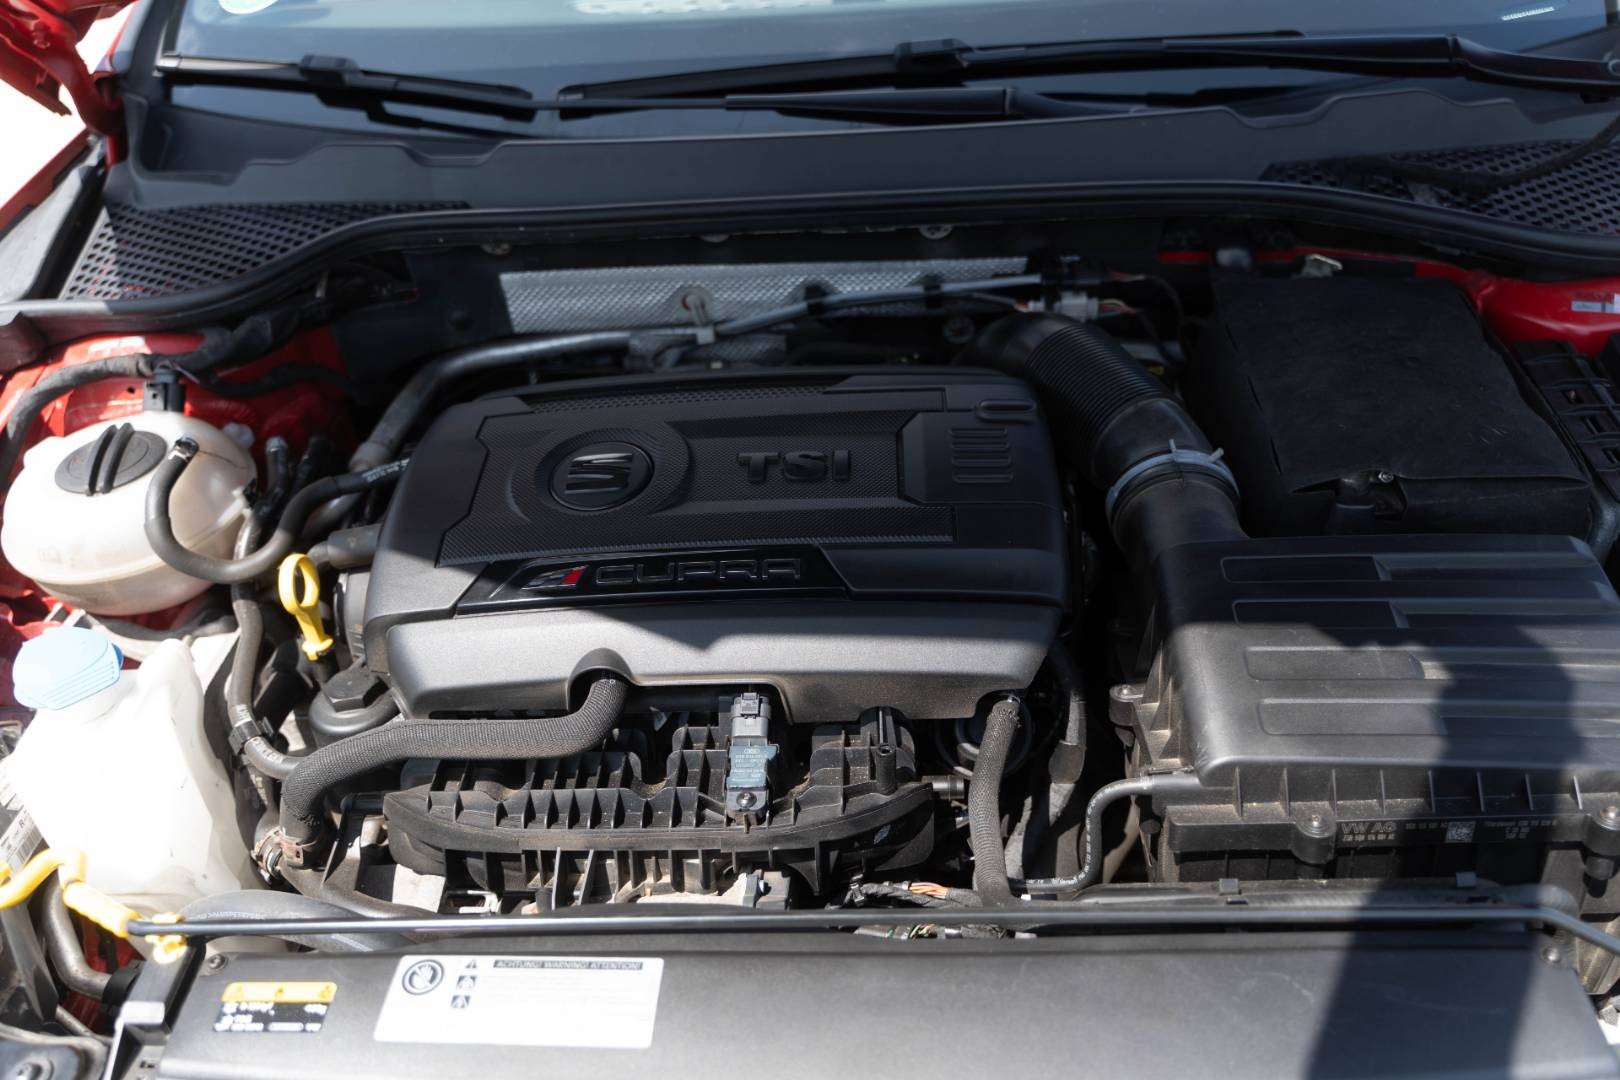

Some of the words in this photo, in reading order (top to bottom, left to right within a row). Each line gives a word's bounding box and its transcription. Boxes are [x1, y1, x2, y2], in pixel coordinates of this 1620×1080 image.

[737, 450, 851, 481] TSI
[595, 557, 801, 585] CUPRA
[1341, 822, 1370, 834] VW
